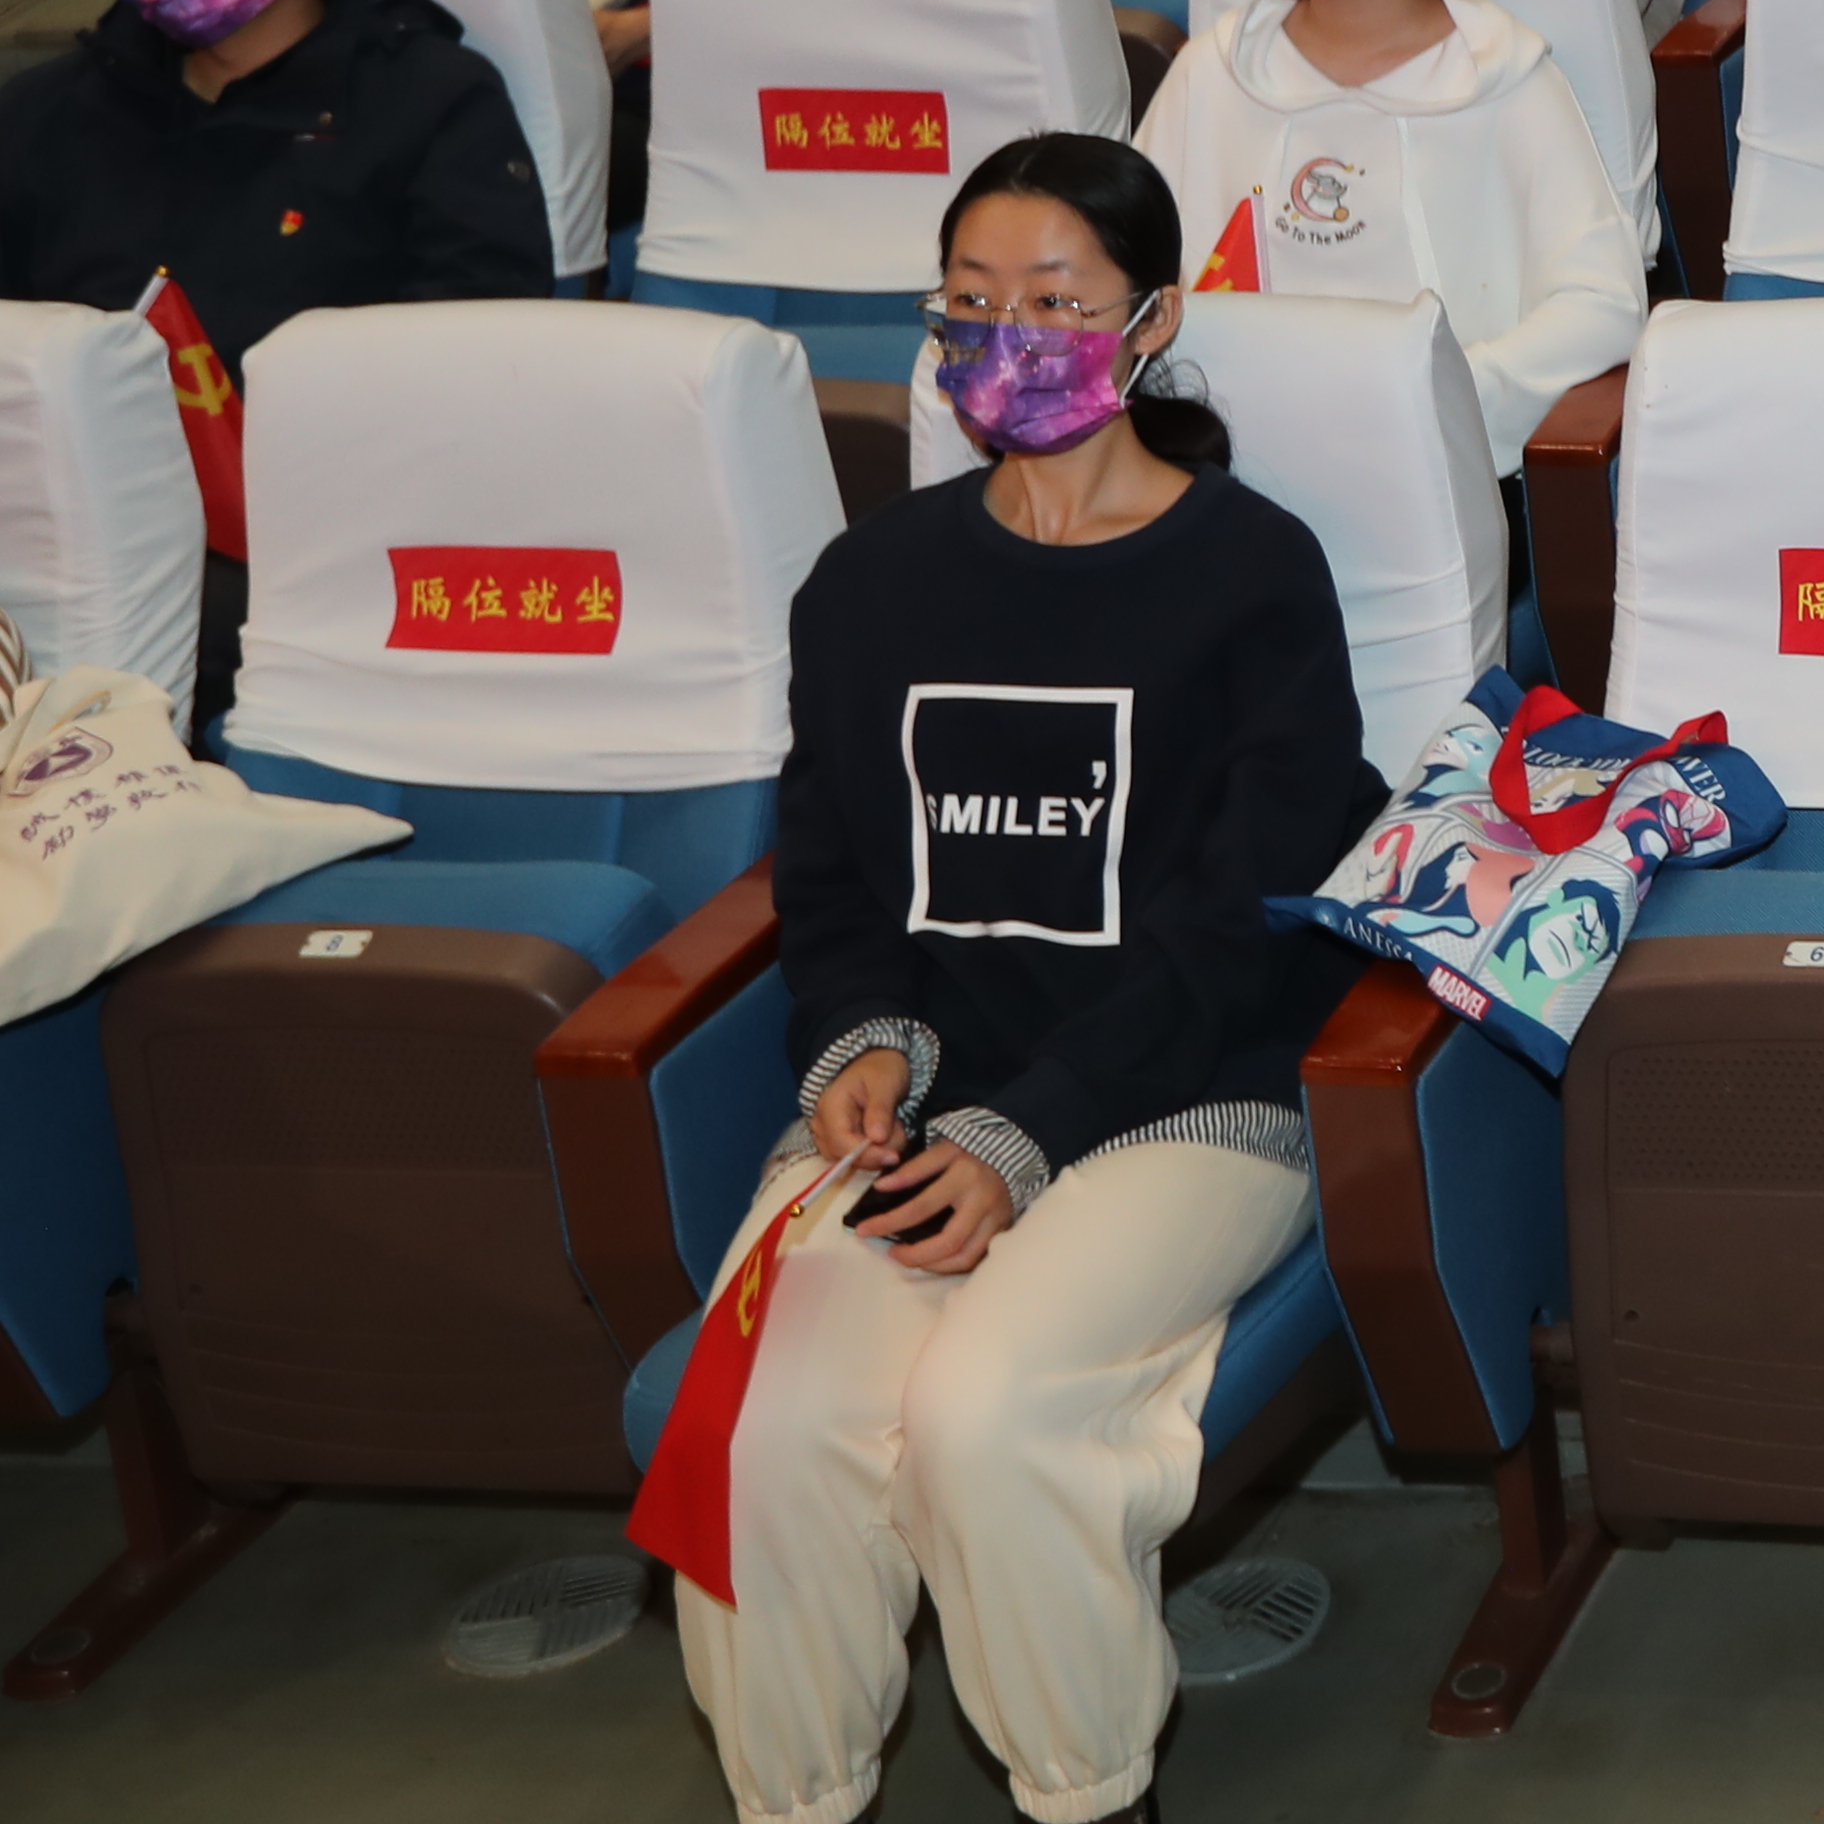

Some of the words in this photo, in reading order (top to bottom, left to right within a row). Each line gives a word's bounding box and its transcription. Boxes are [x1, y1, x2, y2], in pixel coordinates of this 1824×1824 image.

[773, 112, 944, 151] 隔位就坐
[1310, 231, 1332, 246] The
[1334, 219, 1366, 244] Moon
[410, 576, 616, 625] 隔位就坐
[1427, 965, 1488, 1022] MARVEL
